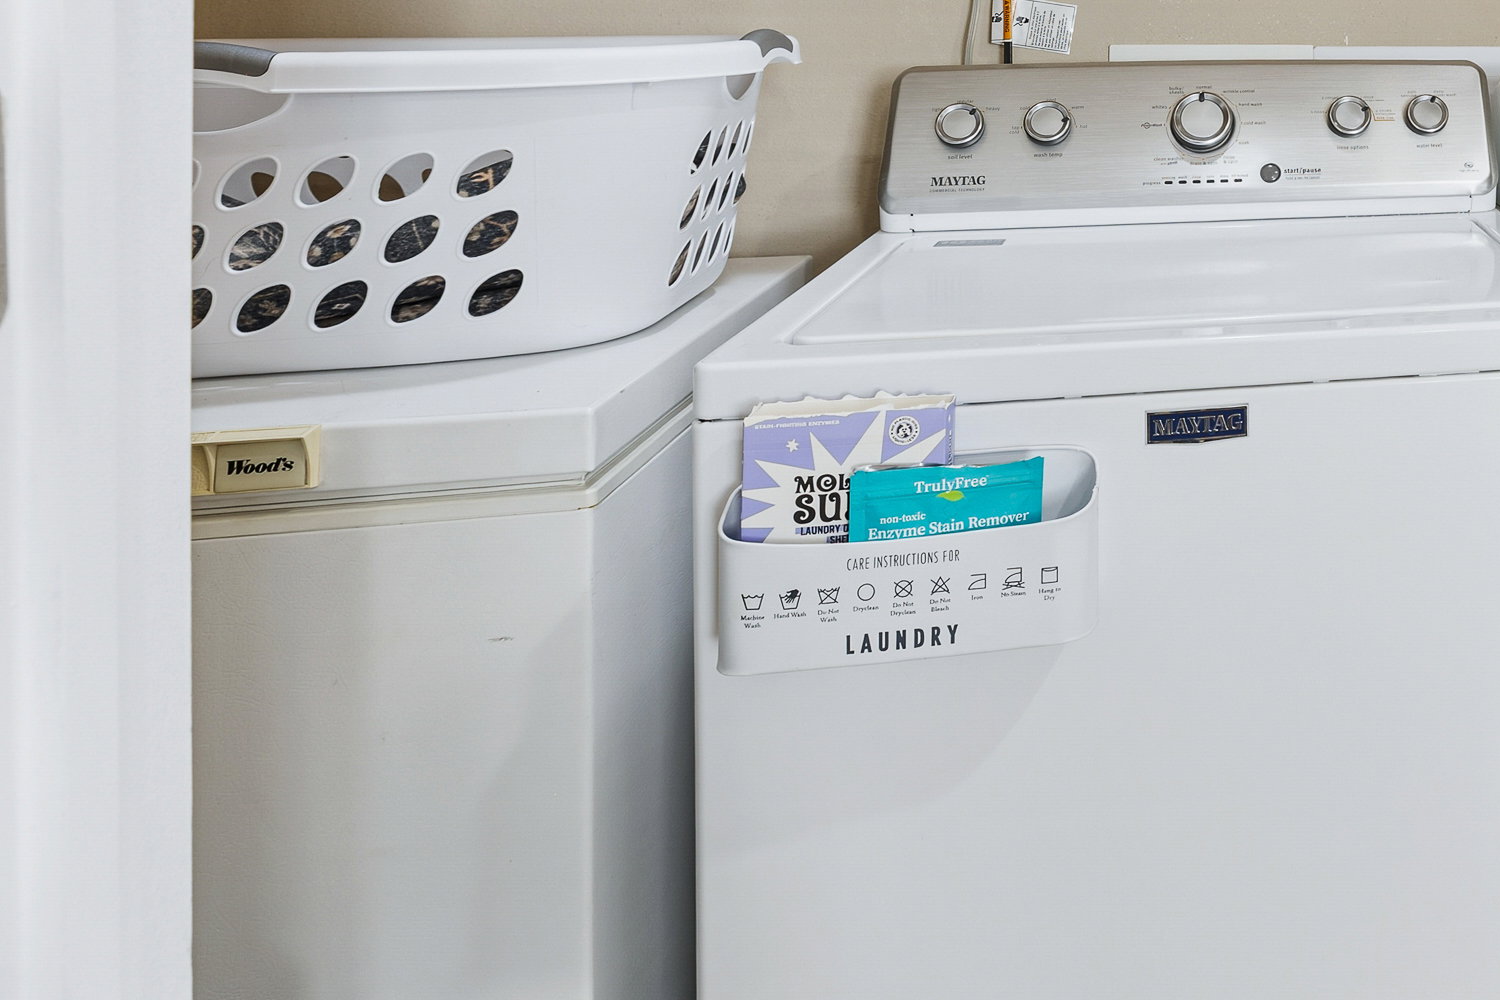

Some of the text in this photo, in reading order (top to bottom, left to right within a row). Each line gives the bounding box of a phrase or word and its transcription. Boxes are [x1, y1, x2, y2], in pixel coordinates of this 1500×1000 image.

[1283, 167, 1322, 175] start/pause
[930, 175, 986, 187] MAYTAG
[754, 419, 840, 430] STAIN-FIGHTING ENZYMES
[1152, 413, 1244, 437] MAYTAG
[226, 457, 295, 476] Wood's
[913, 476, 988, 494] TrulyFree
[879, 511, 926, 525] non-toxic
[799, 525, 840, 536] LAUNDRY
[867, 511, 1030, 541] Enzyme Stain Remover
[846, 549, 960, 571] CARE INSTRUCTIONS FOR
[1043, 593, 1055, 601] Dry
[852, 605, 880, 613] Dryclean
[890, 609, 916, 617] Dryclean
[930, 605, 950, 613] Bleach
[819, 615, 838, 623] Wash
[845, 623, 959, 656] LAUNDRY
